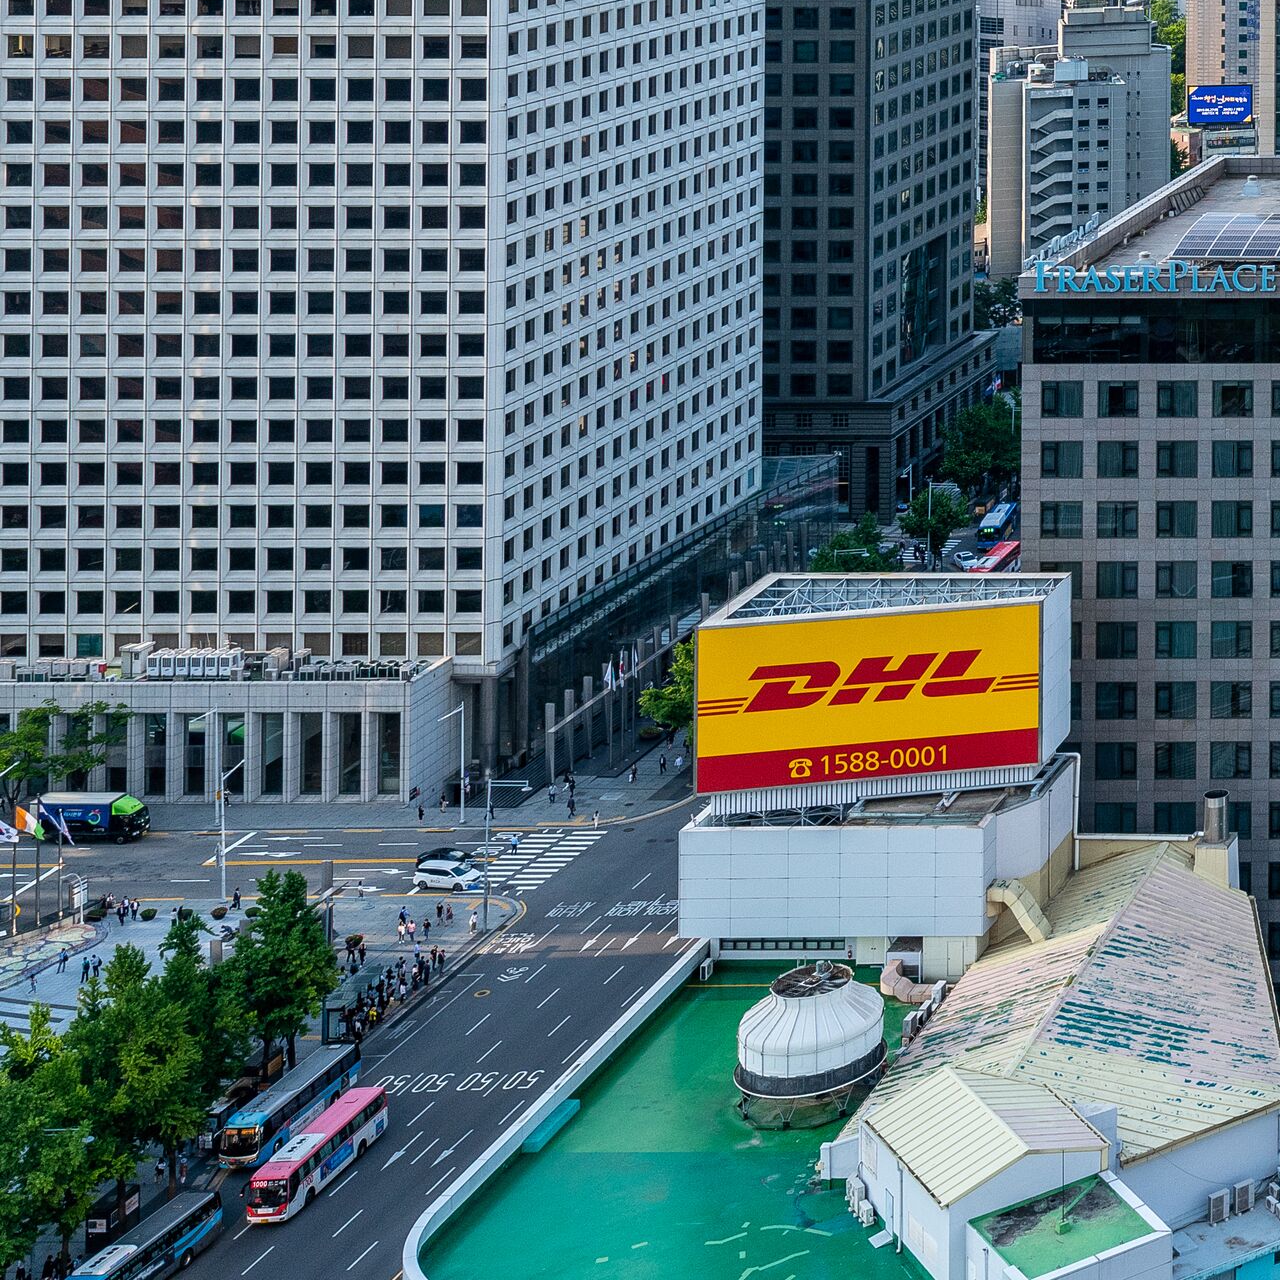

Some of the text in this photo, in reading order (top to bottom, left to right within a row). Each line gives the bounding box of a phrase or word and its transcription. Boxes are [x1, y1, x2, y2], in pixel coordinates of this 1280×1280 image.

[743, 649, 997, 713] DHL
[821, 744, 948, 775] 1588-0001
[375, 1073, 455, 1097] 50/50
[456, 1070, 545, 1097] 50/50
